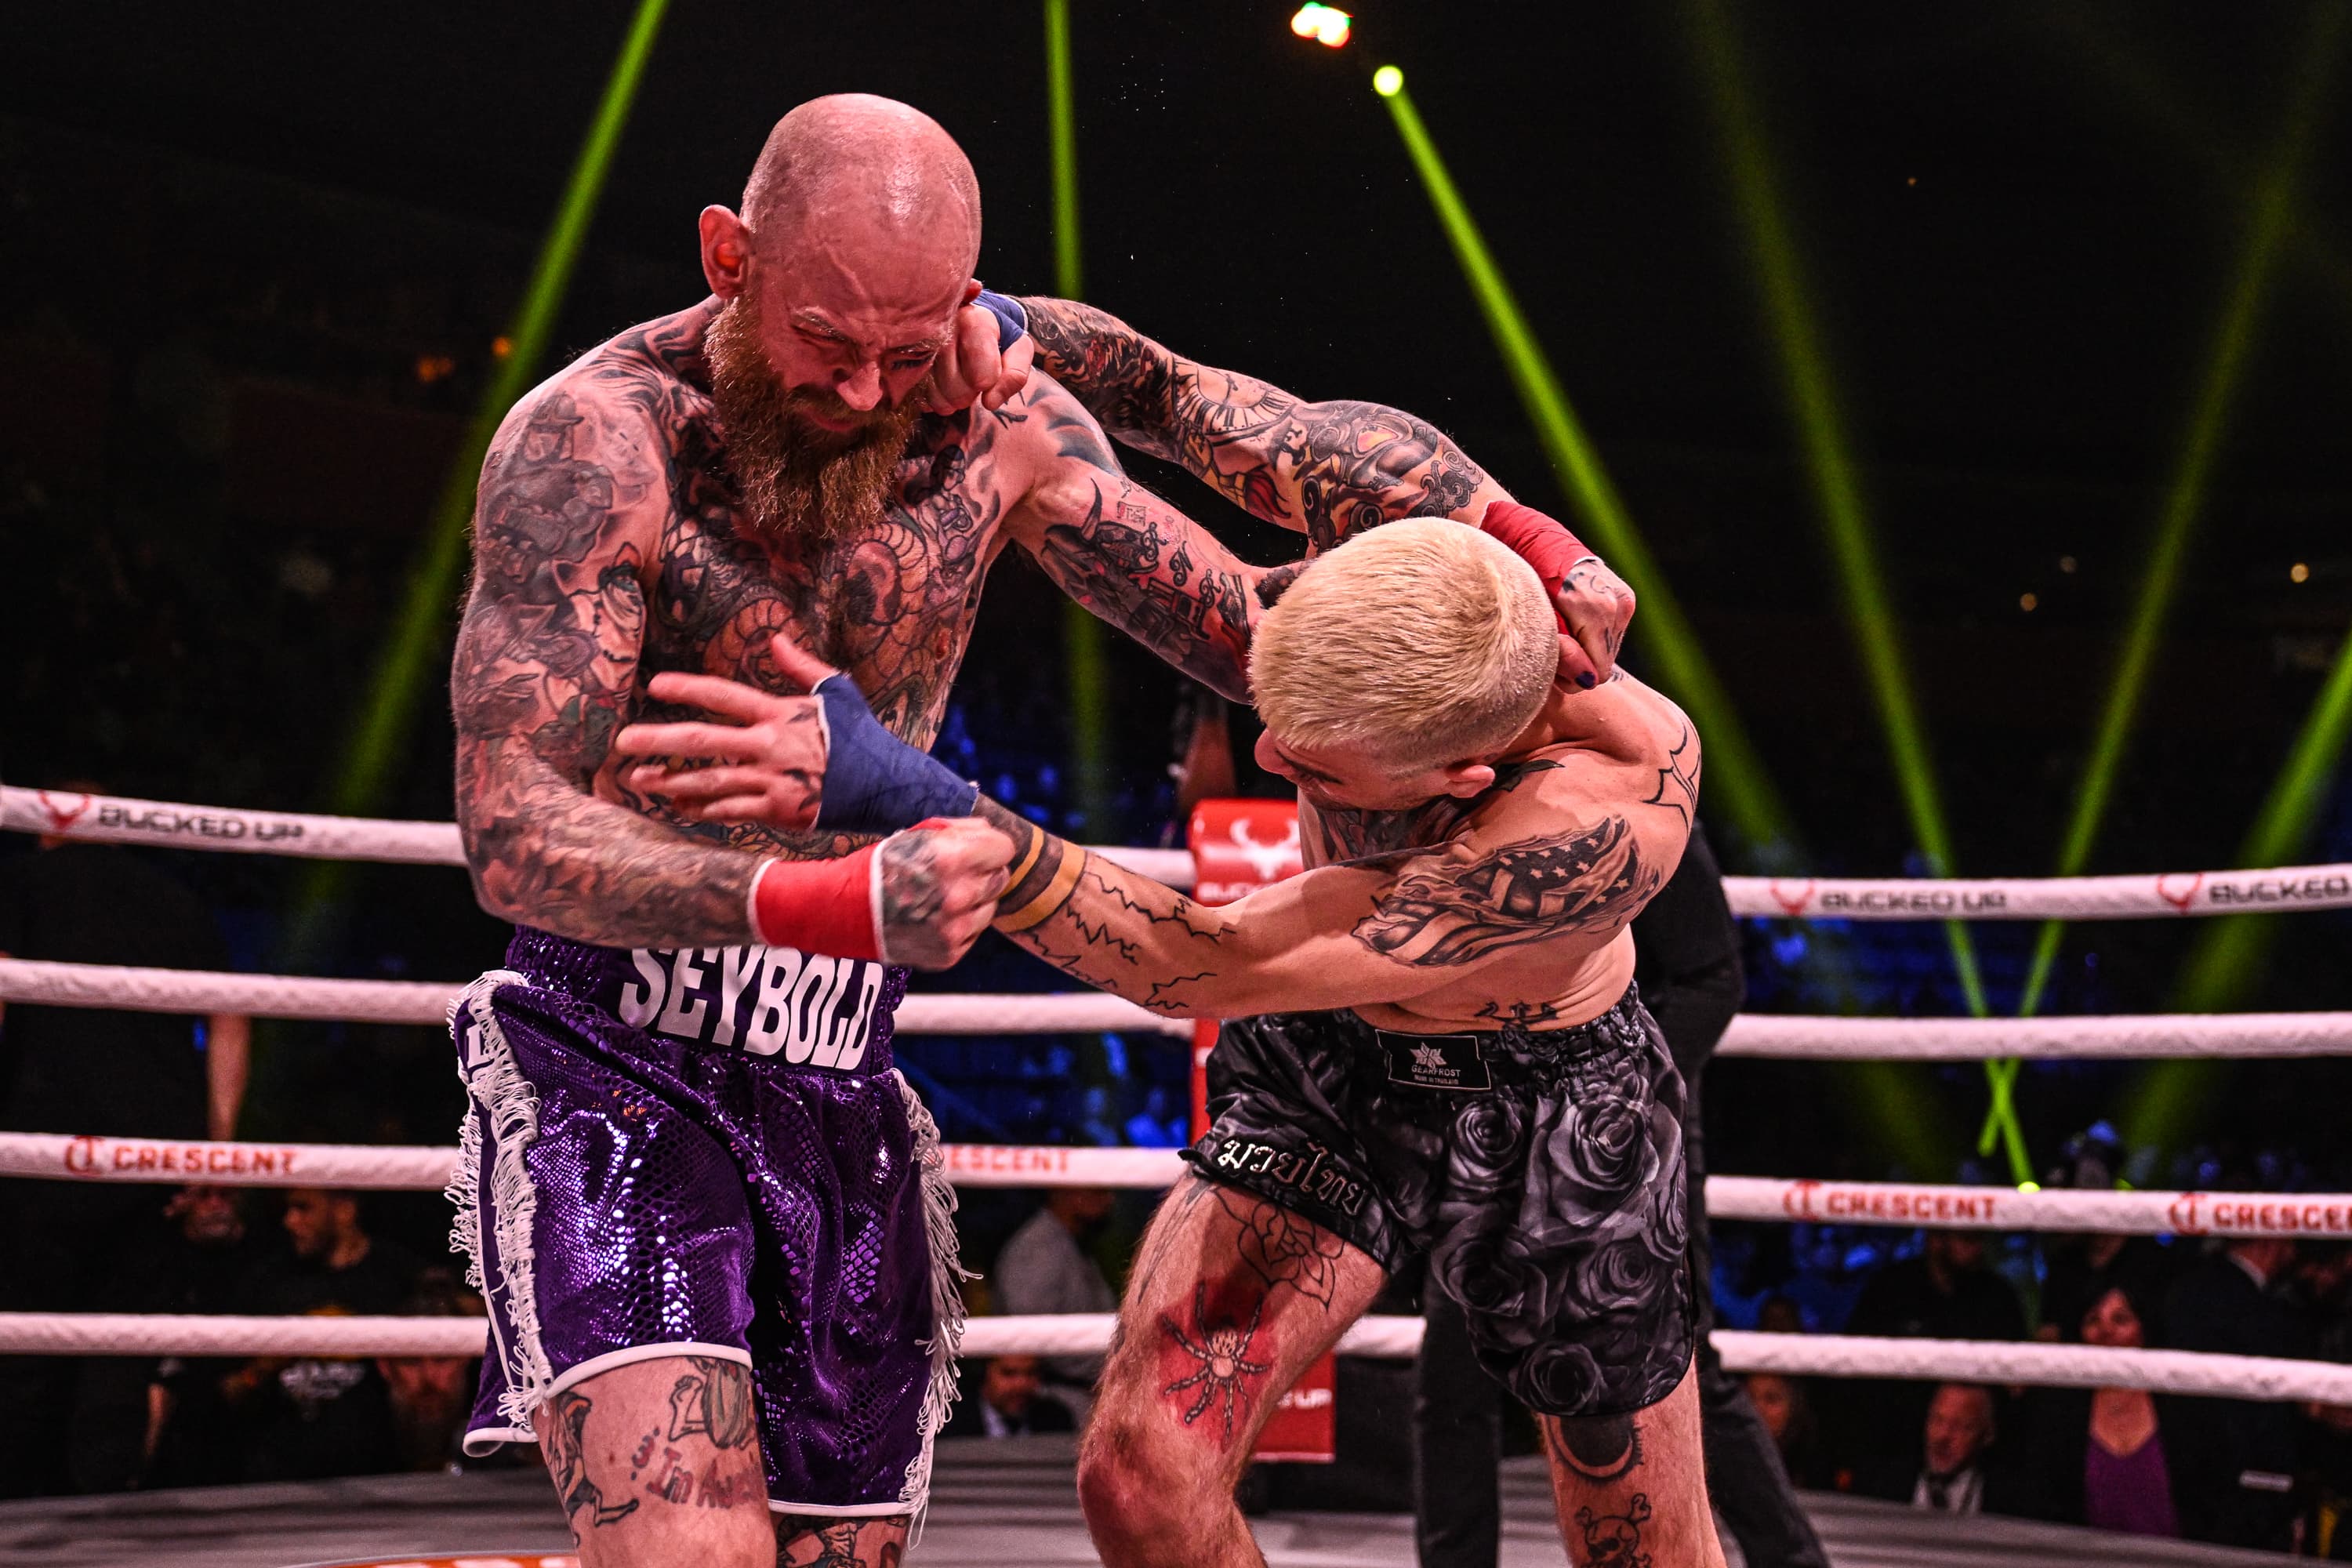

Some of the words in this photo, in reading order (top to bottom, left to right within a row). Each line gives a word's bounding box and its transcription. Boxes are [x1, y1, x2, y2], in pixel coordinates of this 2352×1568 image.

[99, 806, 247, 839] BUCKED
[1821, 891, 1955, 911] BUCKED
[2209, 875, 2350, 903] BUCKED
[618, 943, 884, 1071] SEYBOLD
[1411, 1065, 1461, 1077] GEARFROST
[114, 1145, 297, 1174] CRESCENT
[949, 1145, 1069, 1173] ESCENT
[1826, 1191, 1996, 1220] CRESCENT
[2214, 1203, 2352, 1231] CRESCE
